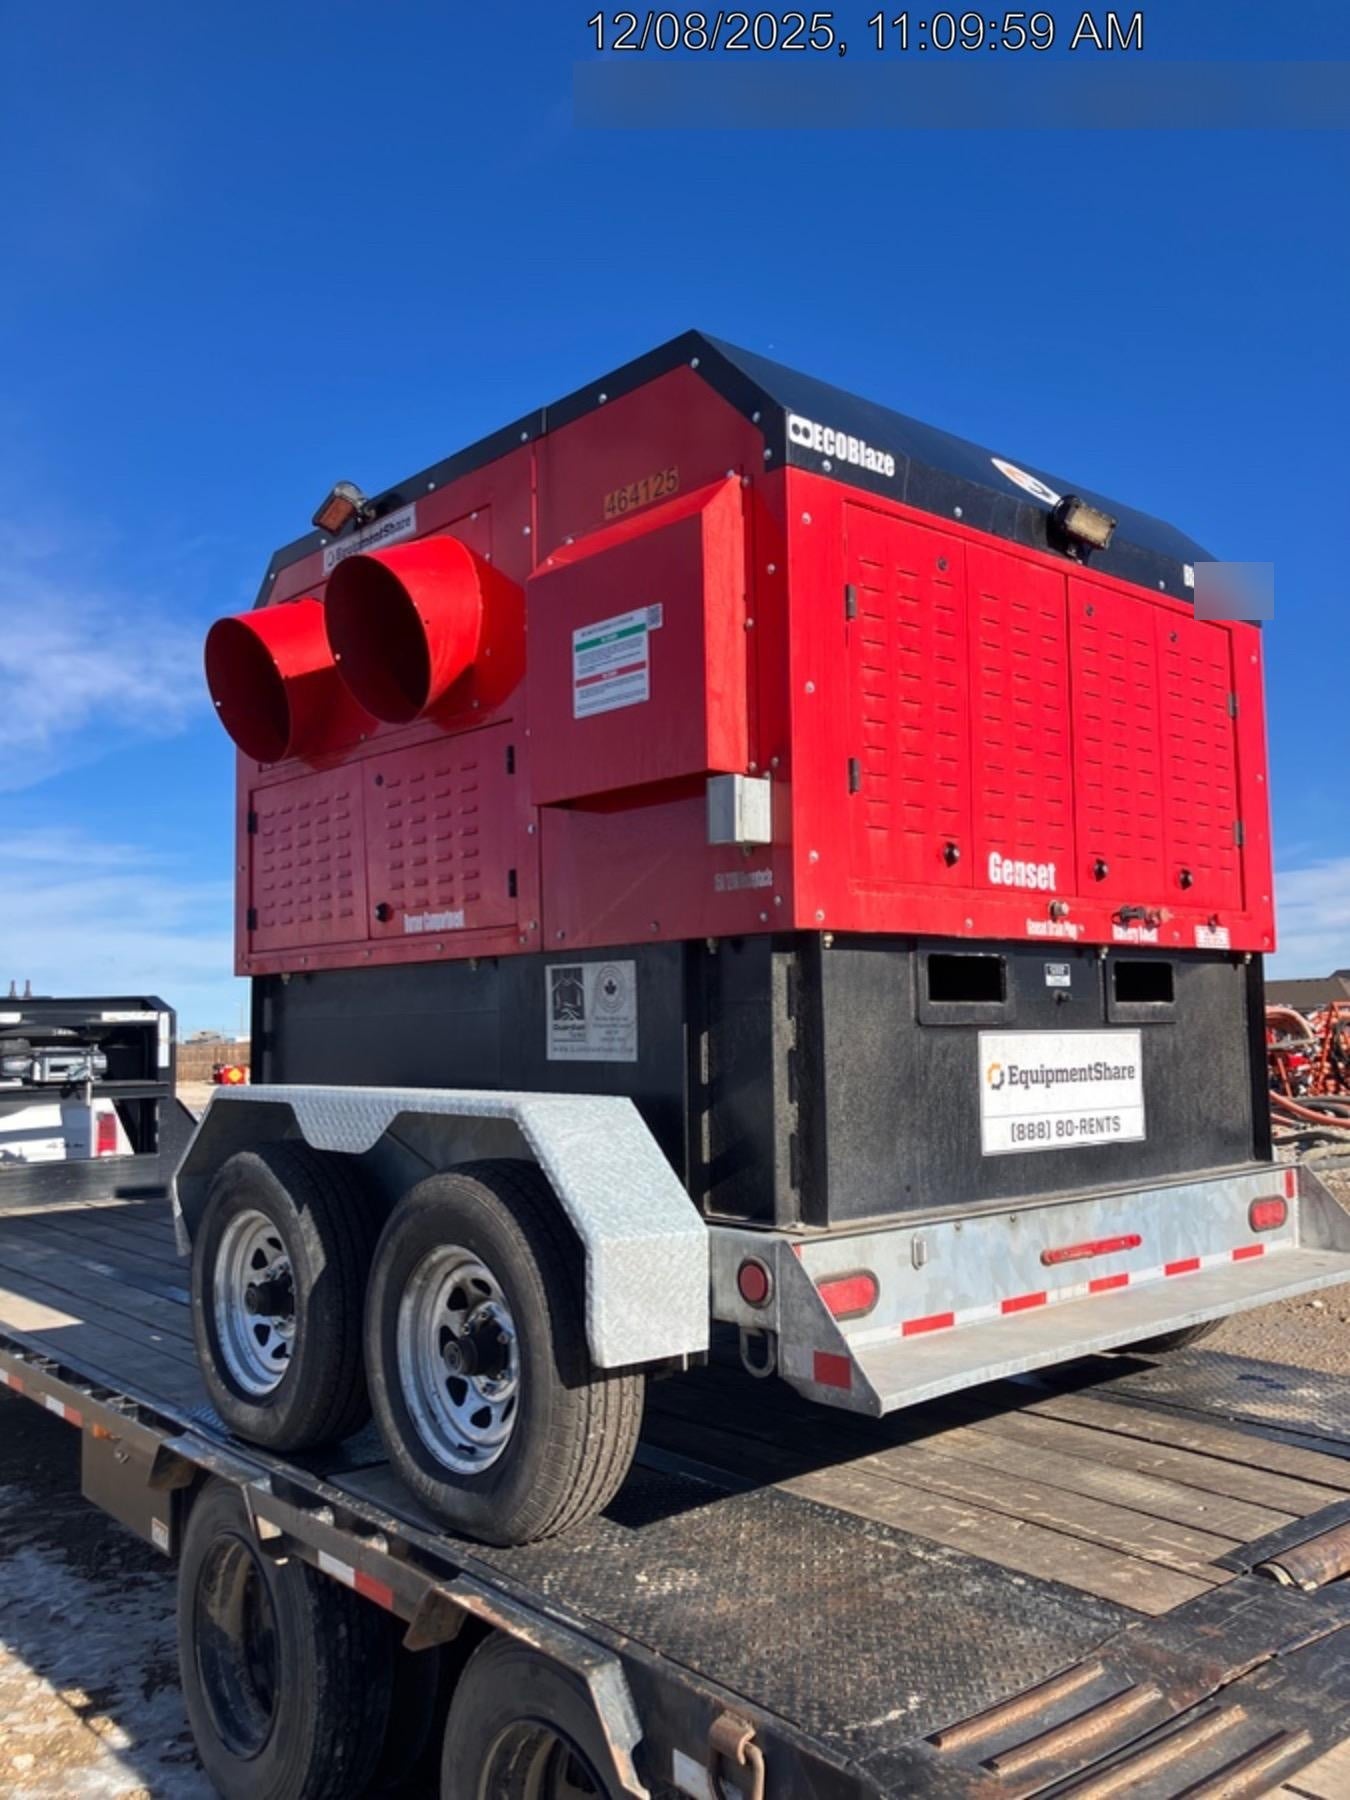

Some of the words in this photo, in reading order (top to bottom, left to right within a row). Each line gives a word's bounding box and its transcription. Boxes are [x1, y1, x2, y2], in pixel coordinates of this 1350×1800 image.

[813, 423, 895, 477] ECOBlaze
[606, 465, 678, 514] 464125
[988, 851, 1057, 892] Genset
[1007, 1061, 1136, 1089] EquipmentShare
[1055, 1115, 1121, 1138] 80-RENTS
